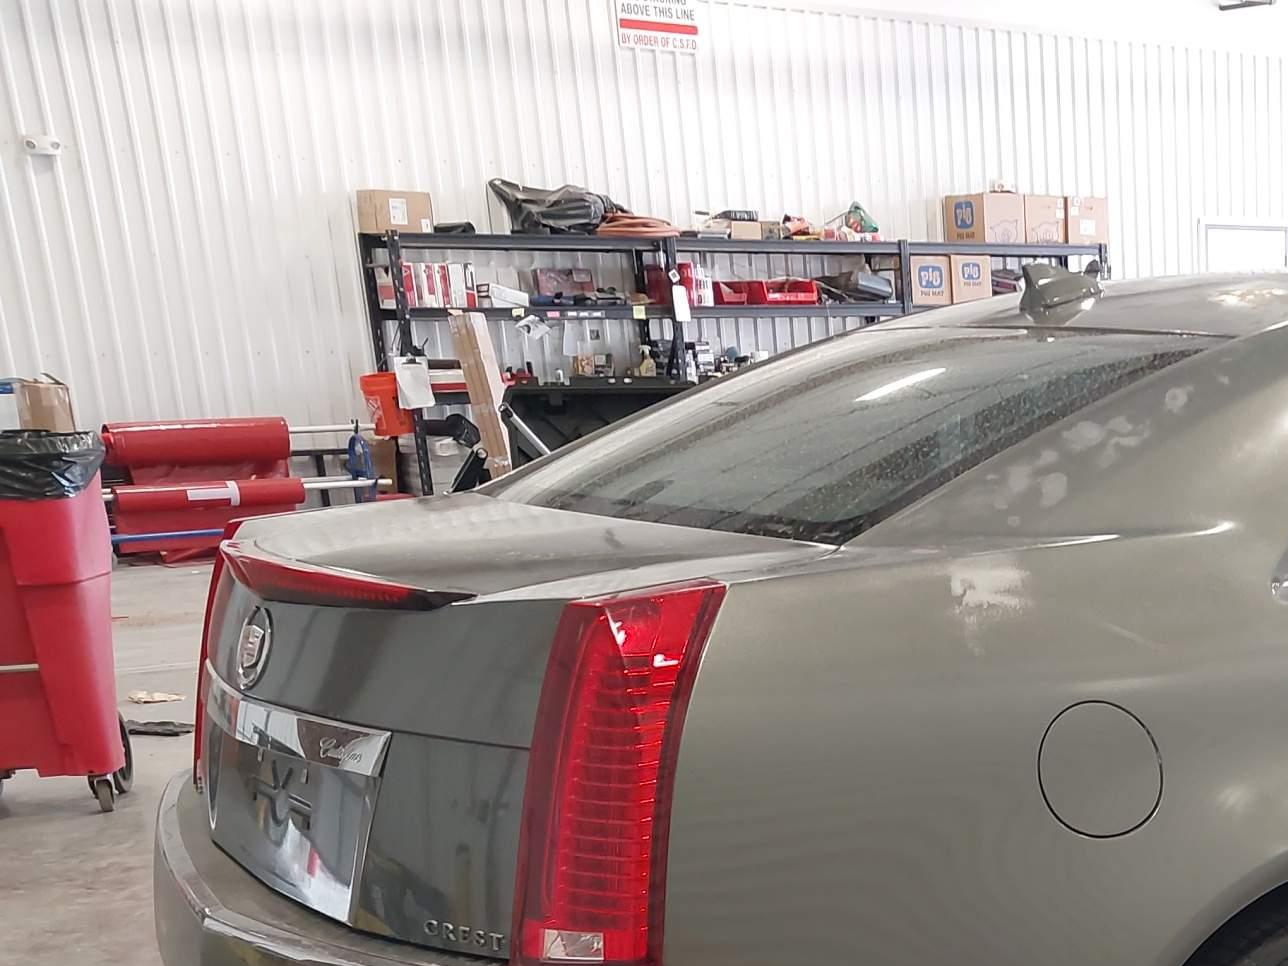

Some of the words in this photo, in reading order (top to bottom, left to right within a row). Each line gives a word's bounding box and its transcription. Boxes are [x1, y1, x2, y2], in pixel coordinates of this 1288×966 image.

[621, 2, 651, 17] ABOVE
[653, 6, 673, 19] THIS
[675, 7, 695, 21] LINE
[621, 32, 631, 44] BY
[633, 34, 659, 48] ORDER
[660, 36, 671, 48] OF
[424, 919, 505, 951] CREST
